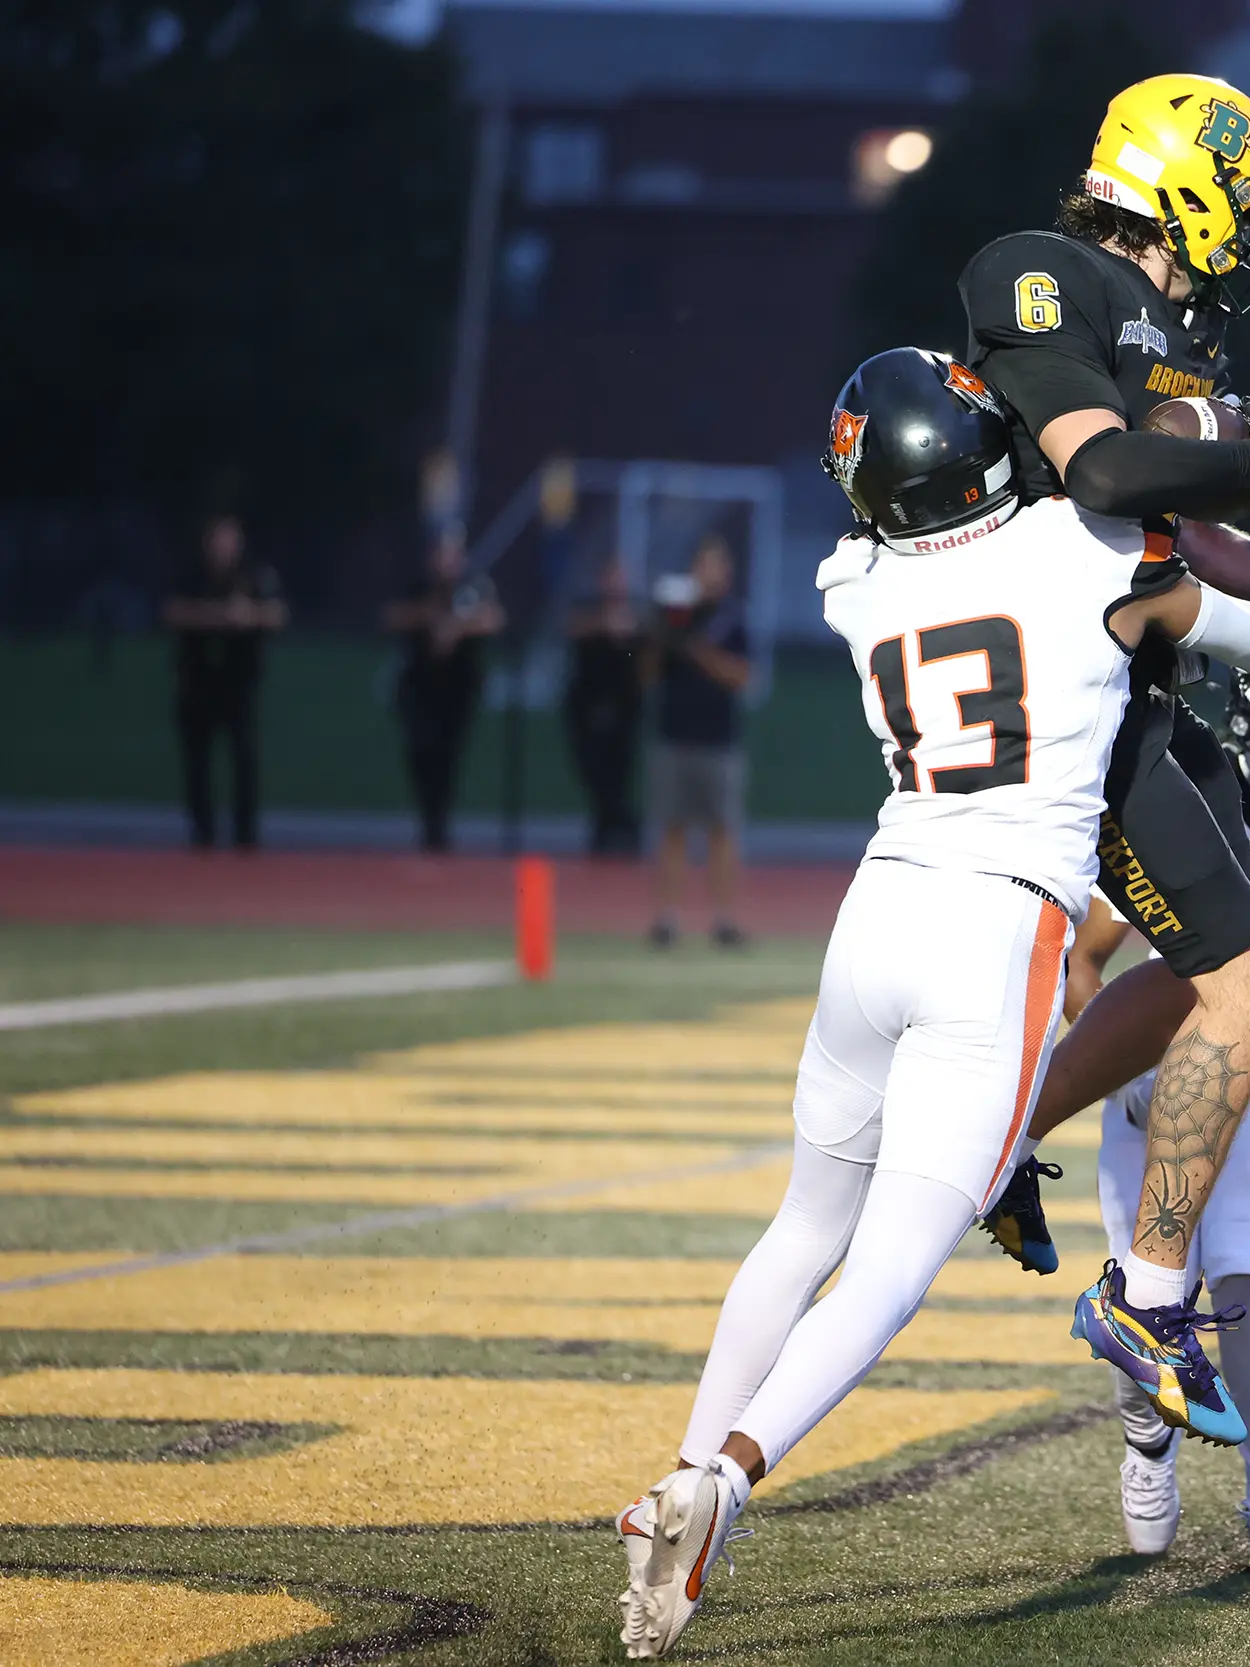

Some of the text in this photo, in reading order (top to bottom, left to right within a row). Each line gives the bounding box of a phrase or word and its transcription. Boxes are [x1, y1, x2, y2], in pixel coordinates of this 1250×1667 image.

[1086, 176, 1114, 201] dell
[1014, 271, 1062, 333] 6
[964, 487, 980, 504] 13
[914, 516, 1001, 553] Riddell
[869, 613, 1032, 795] 13
[1099, 811, 1184, 937] CKPORT
